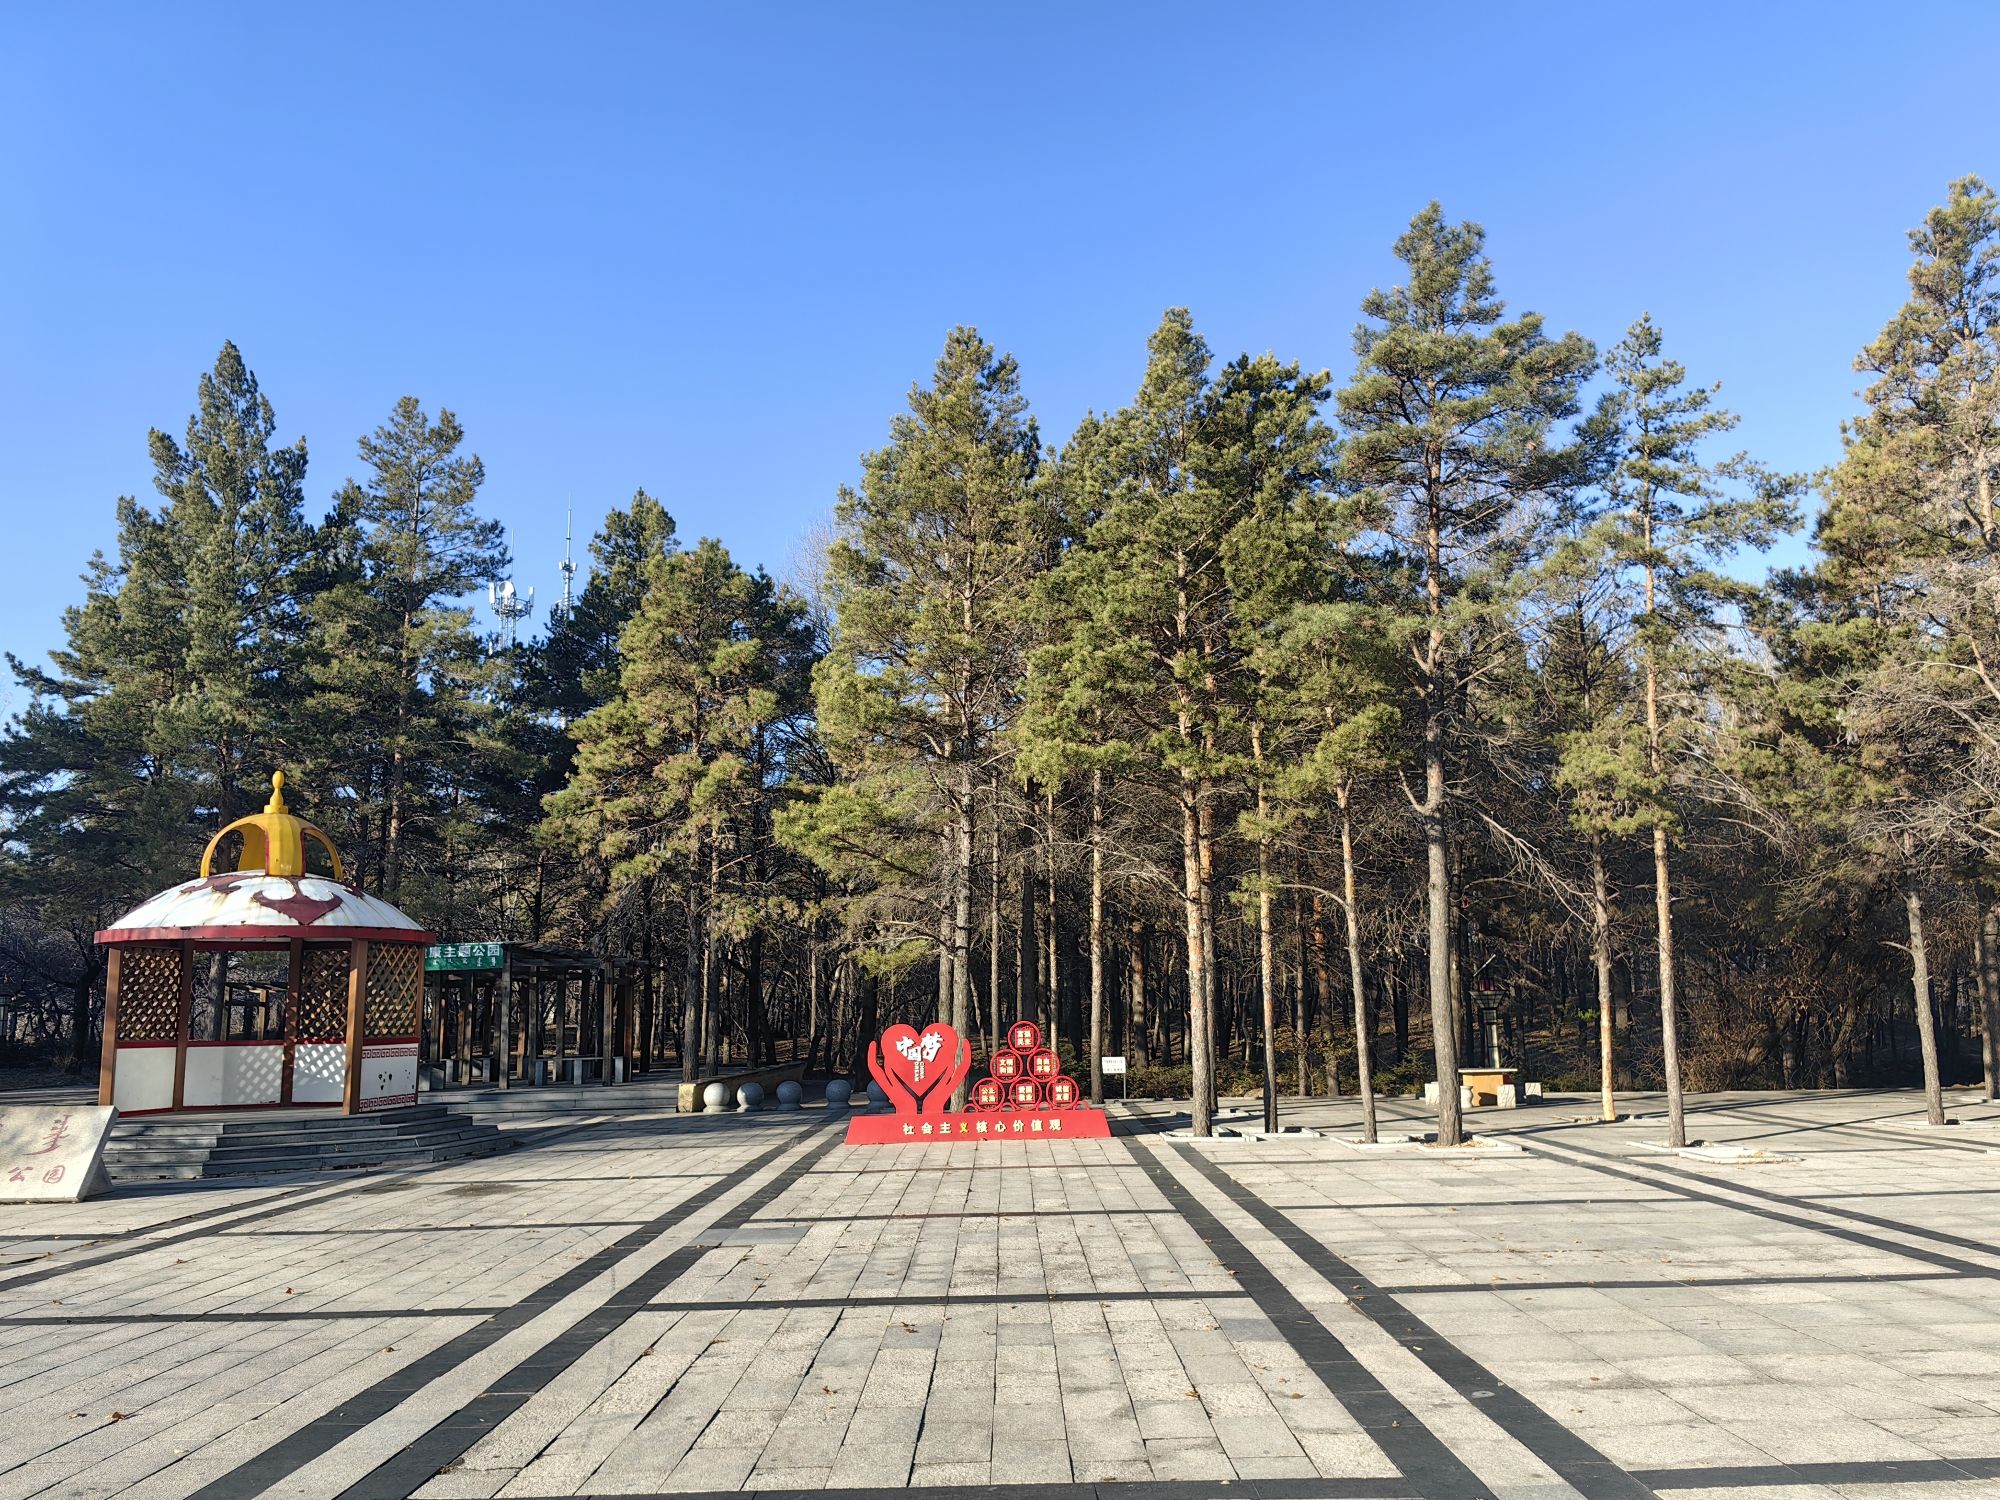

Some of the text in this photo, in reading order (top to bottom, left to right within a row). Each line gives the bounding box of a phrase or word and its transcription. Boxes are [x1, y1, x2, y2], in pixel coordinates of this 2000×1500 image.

[425, 944, 500, 958] 康主题公园
[896, 1031, 944, 1062] 中国梦
[902, 1119, 1062, 1135] 社会主义核心价值观
